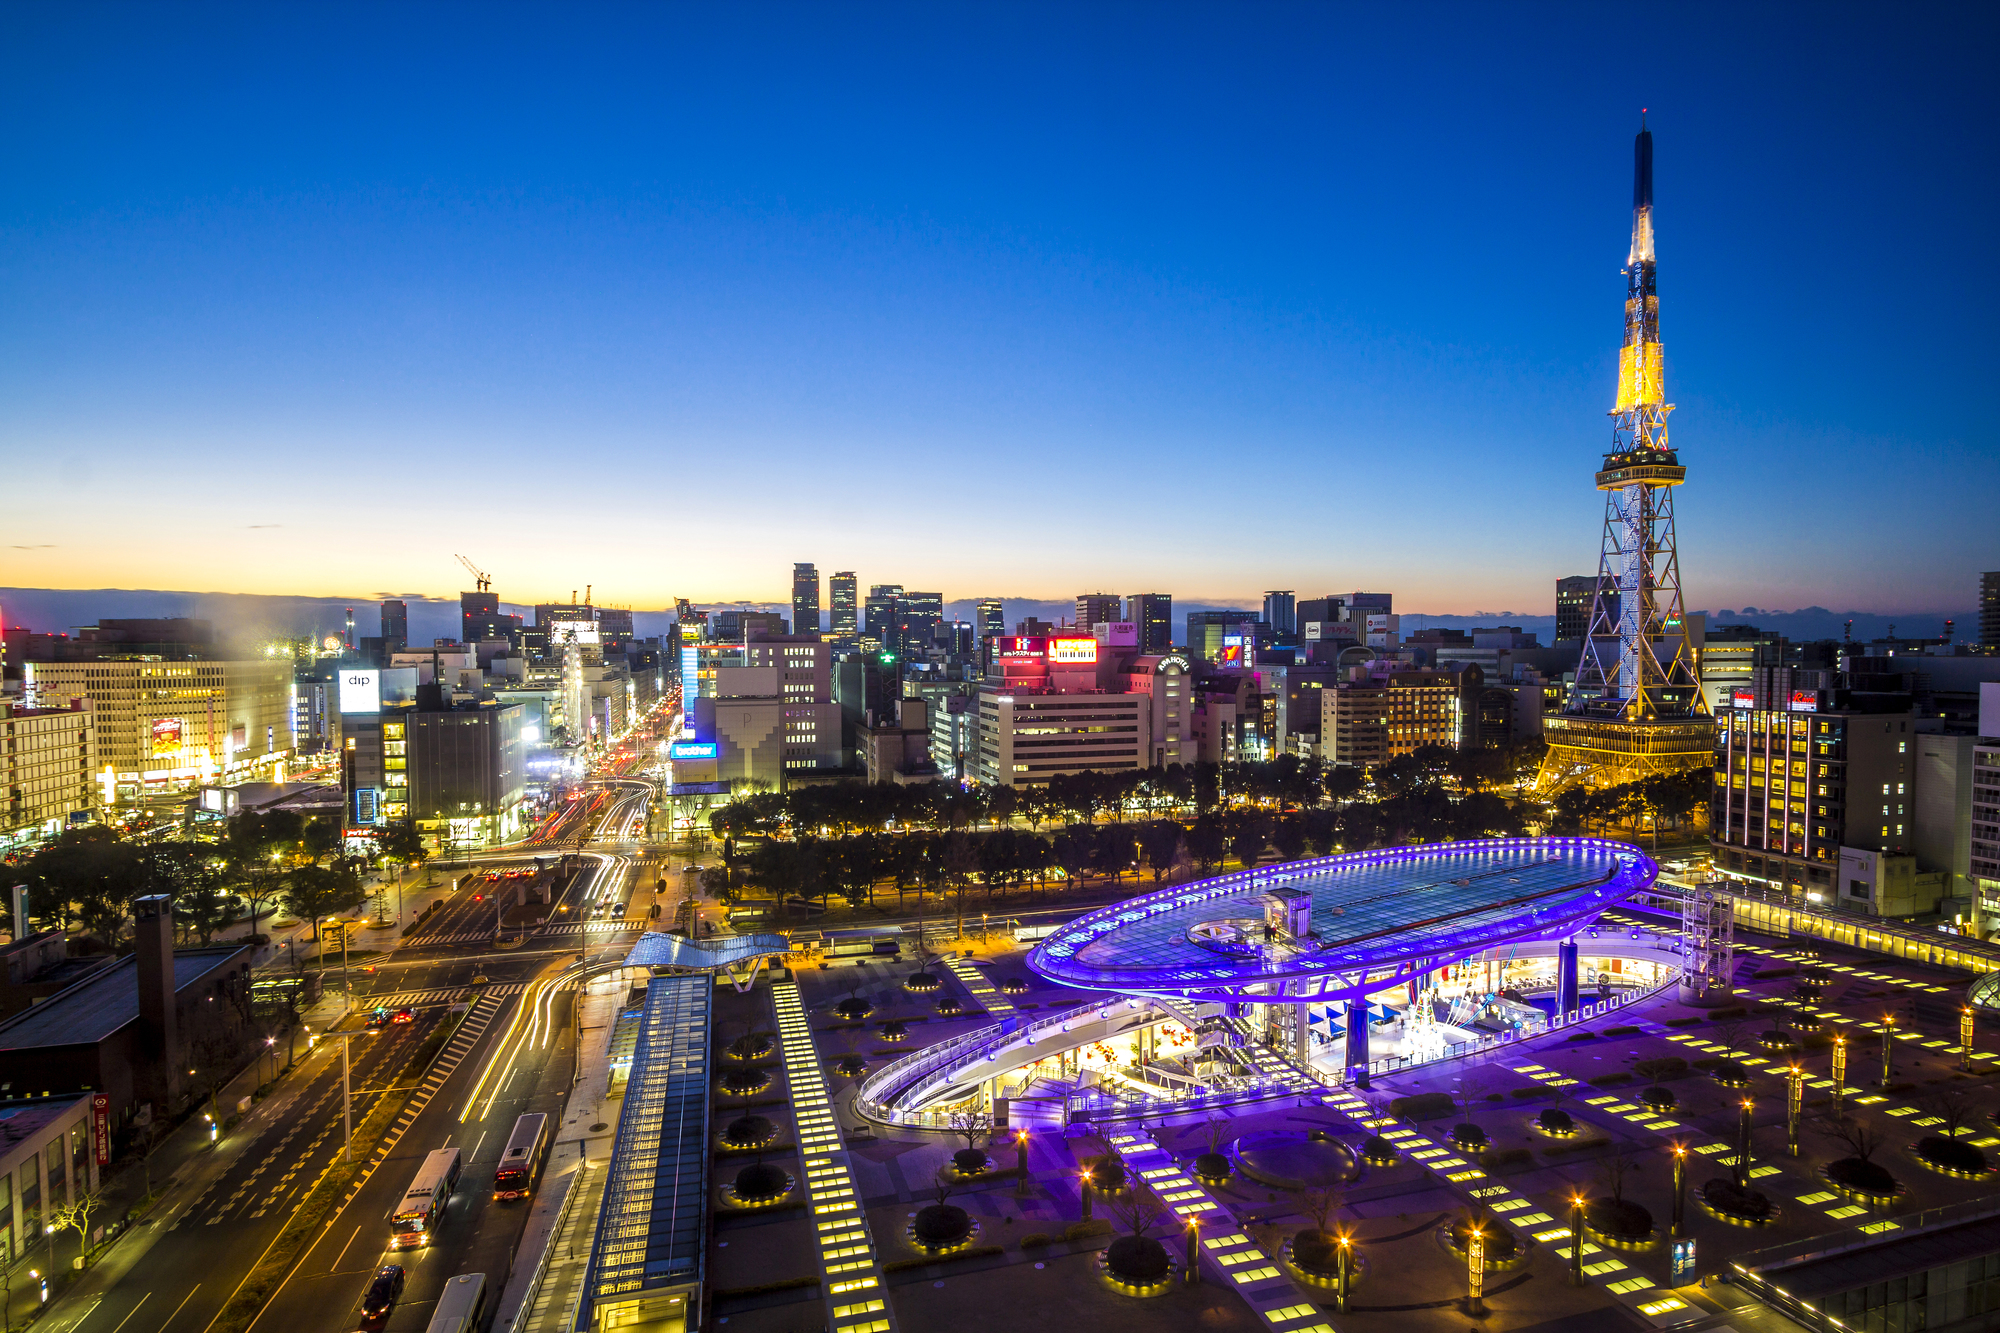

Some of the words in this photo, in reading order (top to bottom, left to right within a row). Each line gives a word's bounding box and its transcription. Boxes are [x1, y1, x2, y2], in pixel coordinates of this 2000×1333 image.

[1158, 658, 1171, 671] APA
[1170, 656, 1190, 672] HOTEL
[349, 675, 370, 687] dip
[676, 746, 713, 756] brother
